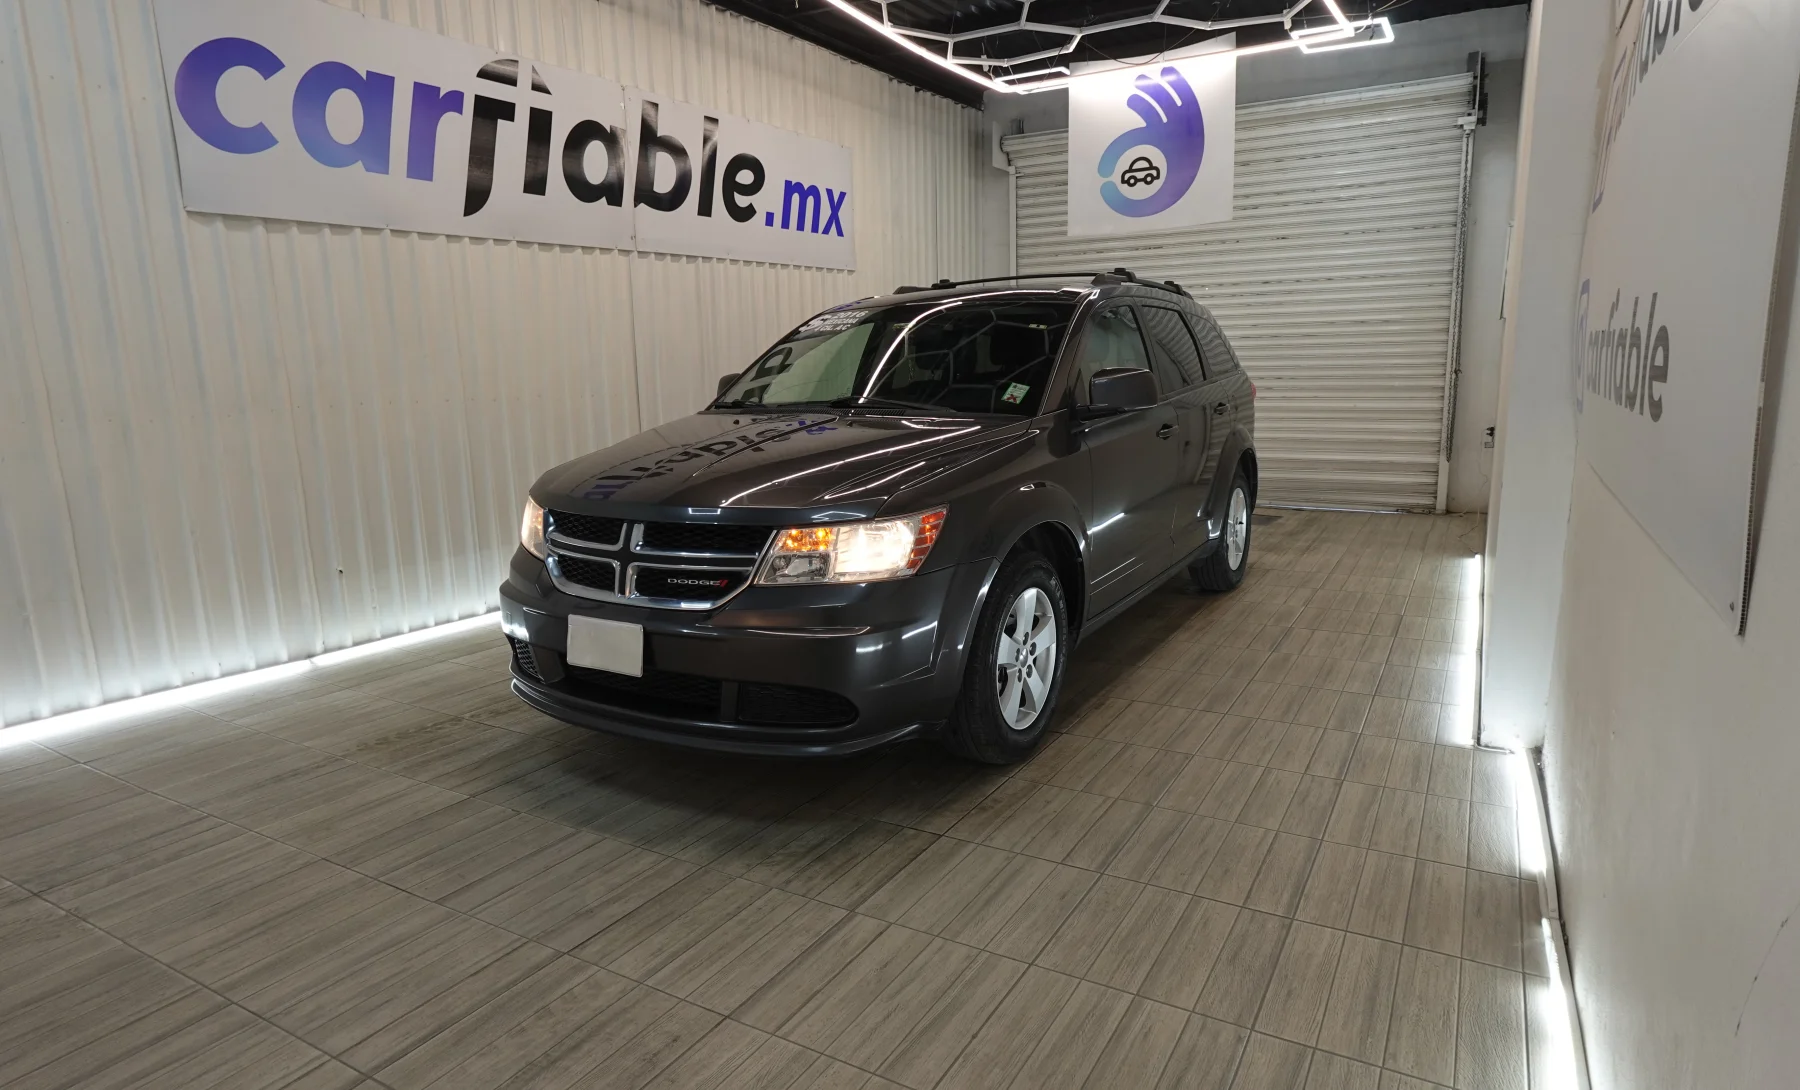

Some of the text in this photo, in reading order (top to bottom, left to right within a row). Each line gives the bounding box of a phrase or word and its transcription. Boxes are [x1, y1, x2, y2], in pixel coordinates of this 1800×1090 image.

[174, 37, 847, 238] carfiable.mx
[832, 311, 869, 319] 2016
[1586, 287, 1670, 423] carfiable
[667, 578, 721, 586] DODGE
